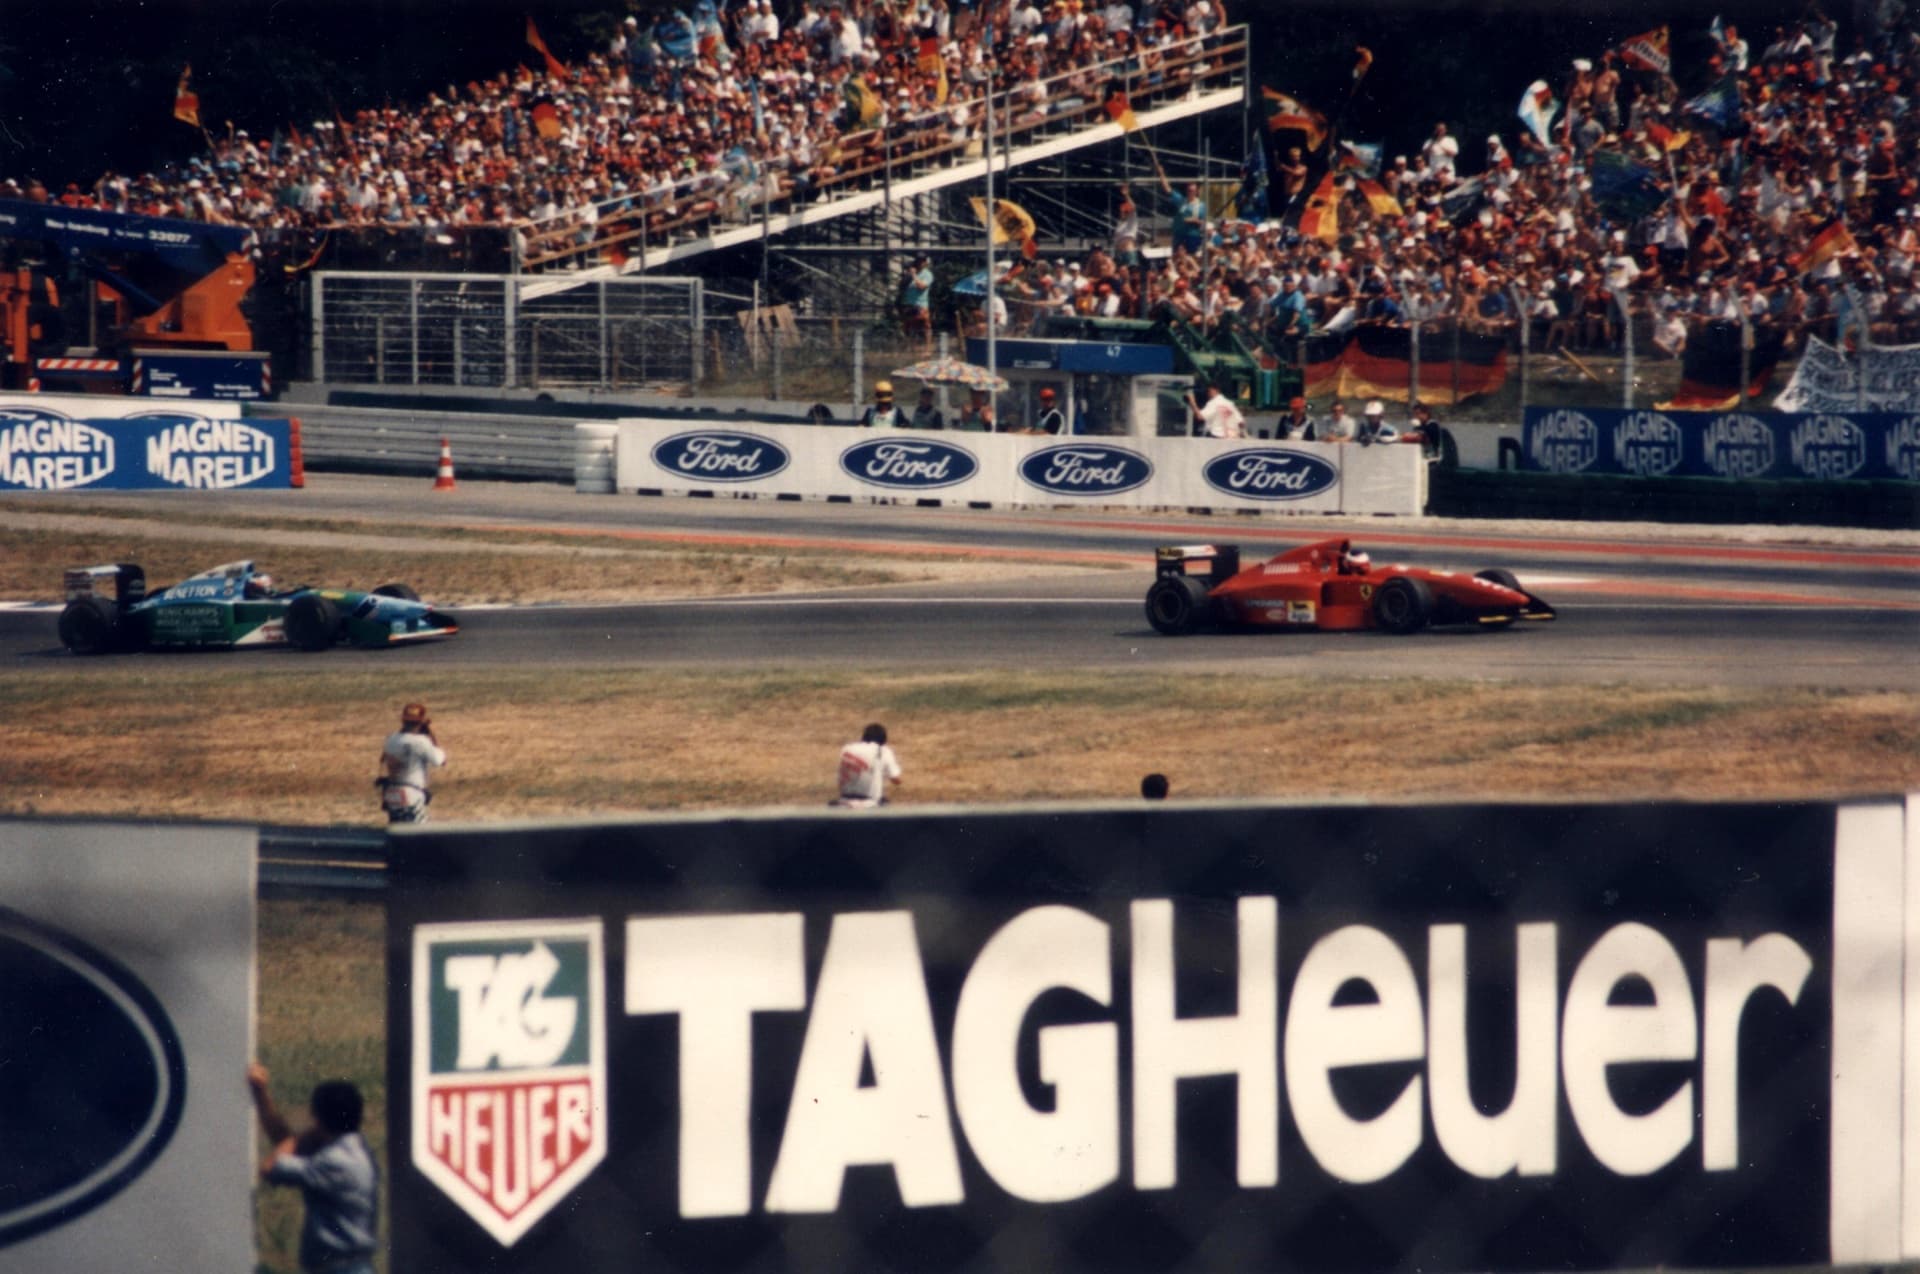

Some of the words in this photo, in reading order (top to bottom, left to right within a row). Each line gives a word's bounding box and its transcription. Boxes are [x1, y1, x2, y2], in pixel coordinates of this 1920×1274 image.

[147, 420, 275, 454] MAGNETI
[678, 437, 761, 472] Ford
[866, 444, 951, 479] Ford
[1045, 451, 1125, 485] Ford
[1228, 455, 1310, 489] Ford
[445, 939, 577, 1071] TAG
[430, 1083, 590, 1213] HEUER
